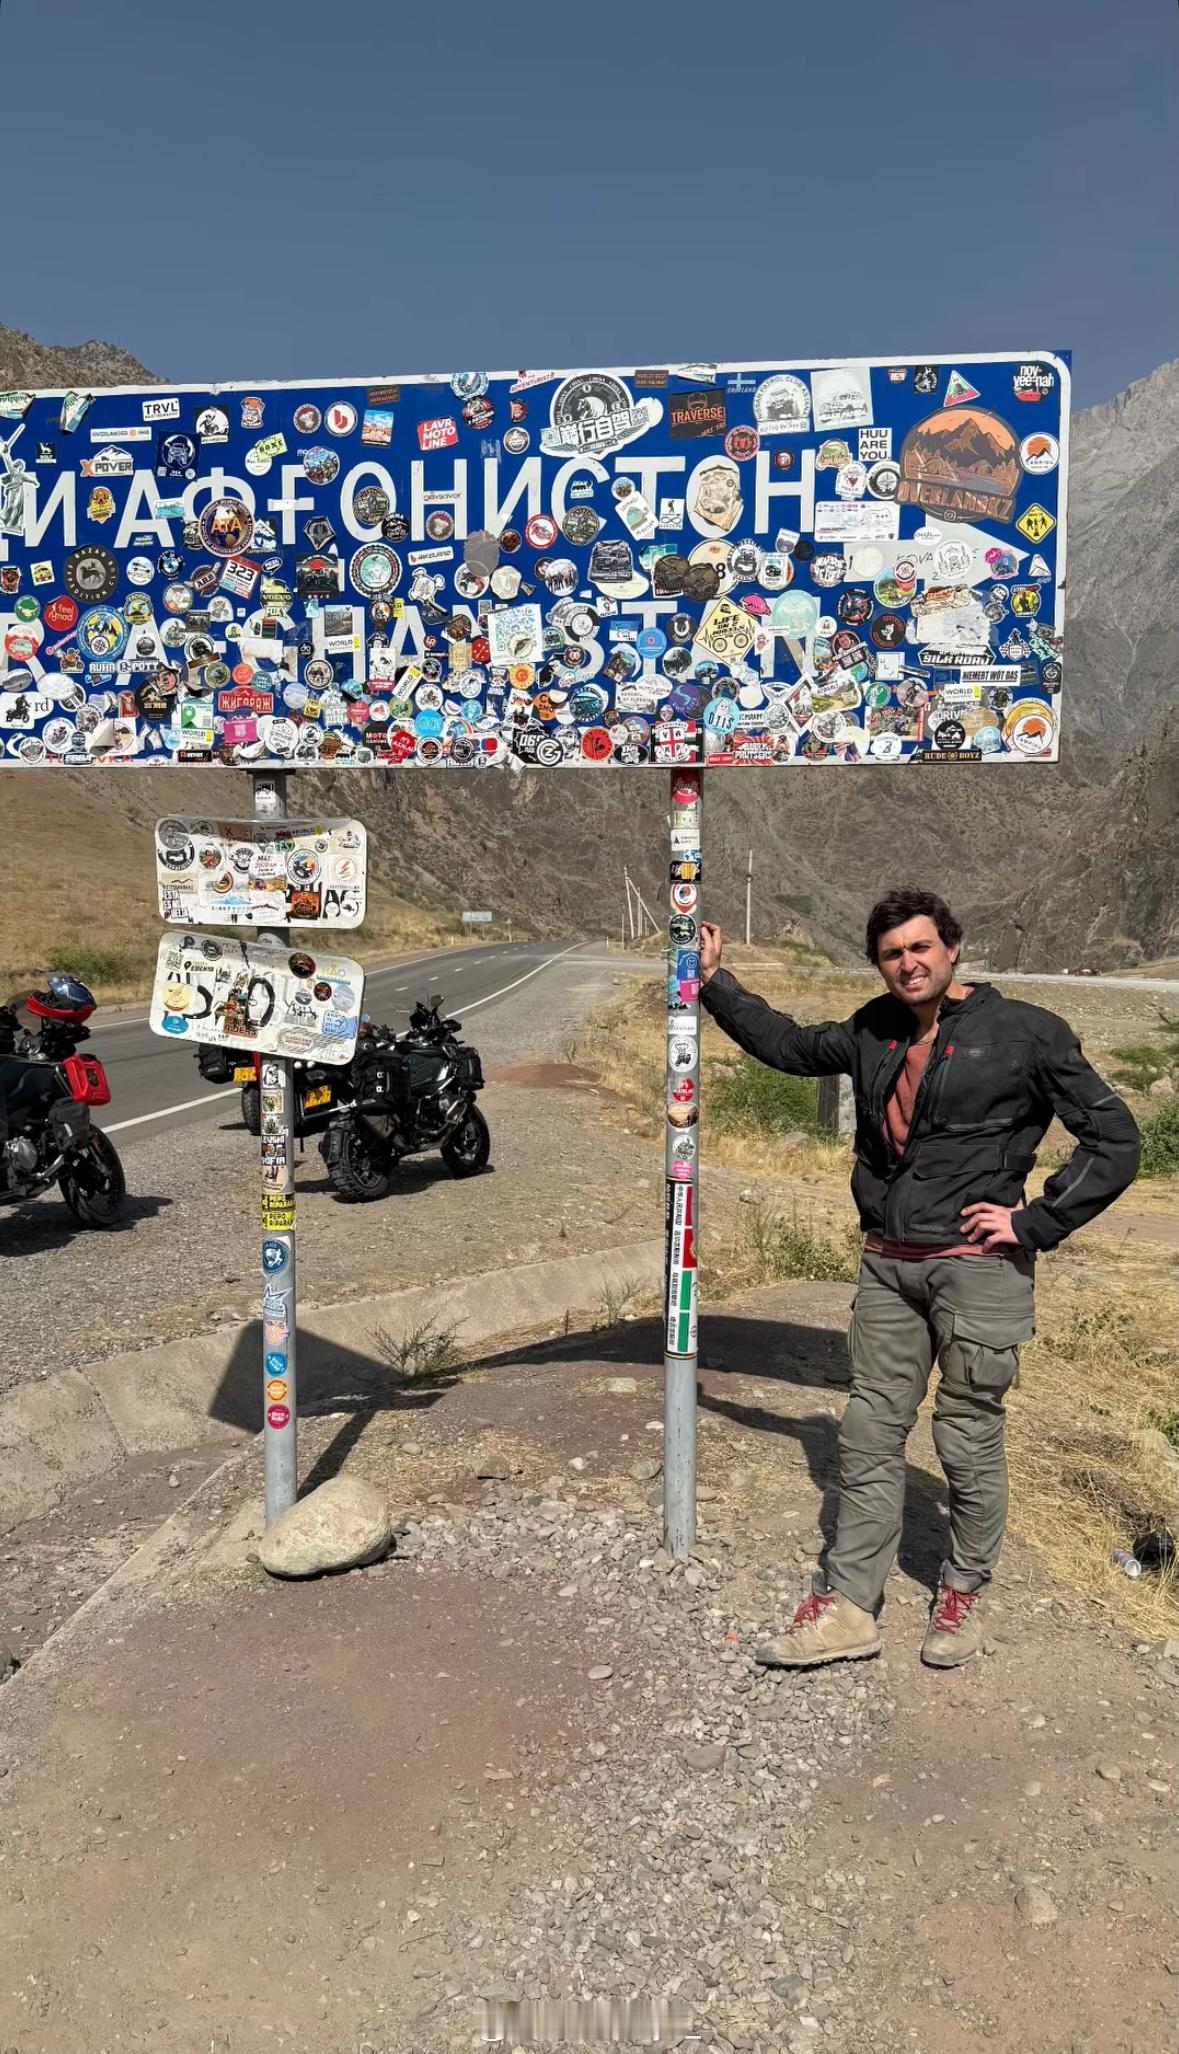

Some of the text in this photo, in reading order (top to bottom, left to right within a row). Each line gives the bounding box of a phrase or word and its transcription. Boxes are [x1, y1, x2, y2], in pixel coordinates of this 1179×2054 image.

[144, 402, 178, 415] TRVL
[423, 417, 453, 432] LAVR
[422, 427, 456, 441] MOTO
[860, 430, 888, 439] HUU
[421, 437, 449, 450] LINE
[860, 440, 888, 449] ARE
[211, 516, 243, 533] ATA
[226, 559, 256, 582] 323
[262, 593, 292, 601] VOLVO
[265, 605, 288, 618] FOXY
[713, 614, 740, 627] LIFE
[328, 639, 354, 649] WORLD
[921, 654, 954, 665] SILK
[89, 662, 116, 673] RUHR
[1005, 670, 1019, 680] DAS
[395, 674, 414, 697] WORLD
[946, 687, 973, 696] WORLD
[708, 711, 735, 730] OTIS
[181, 729, 206, 739] WORLD
[924, 751, 947, 760] RUDE
